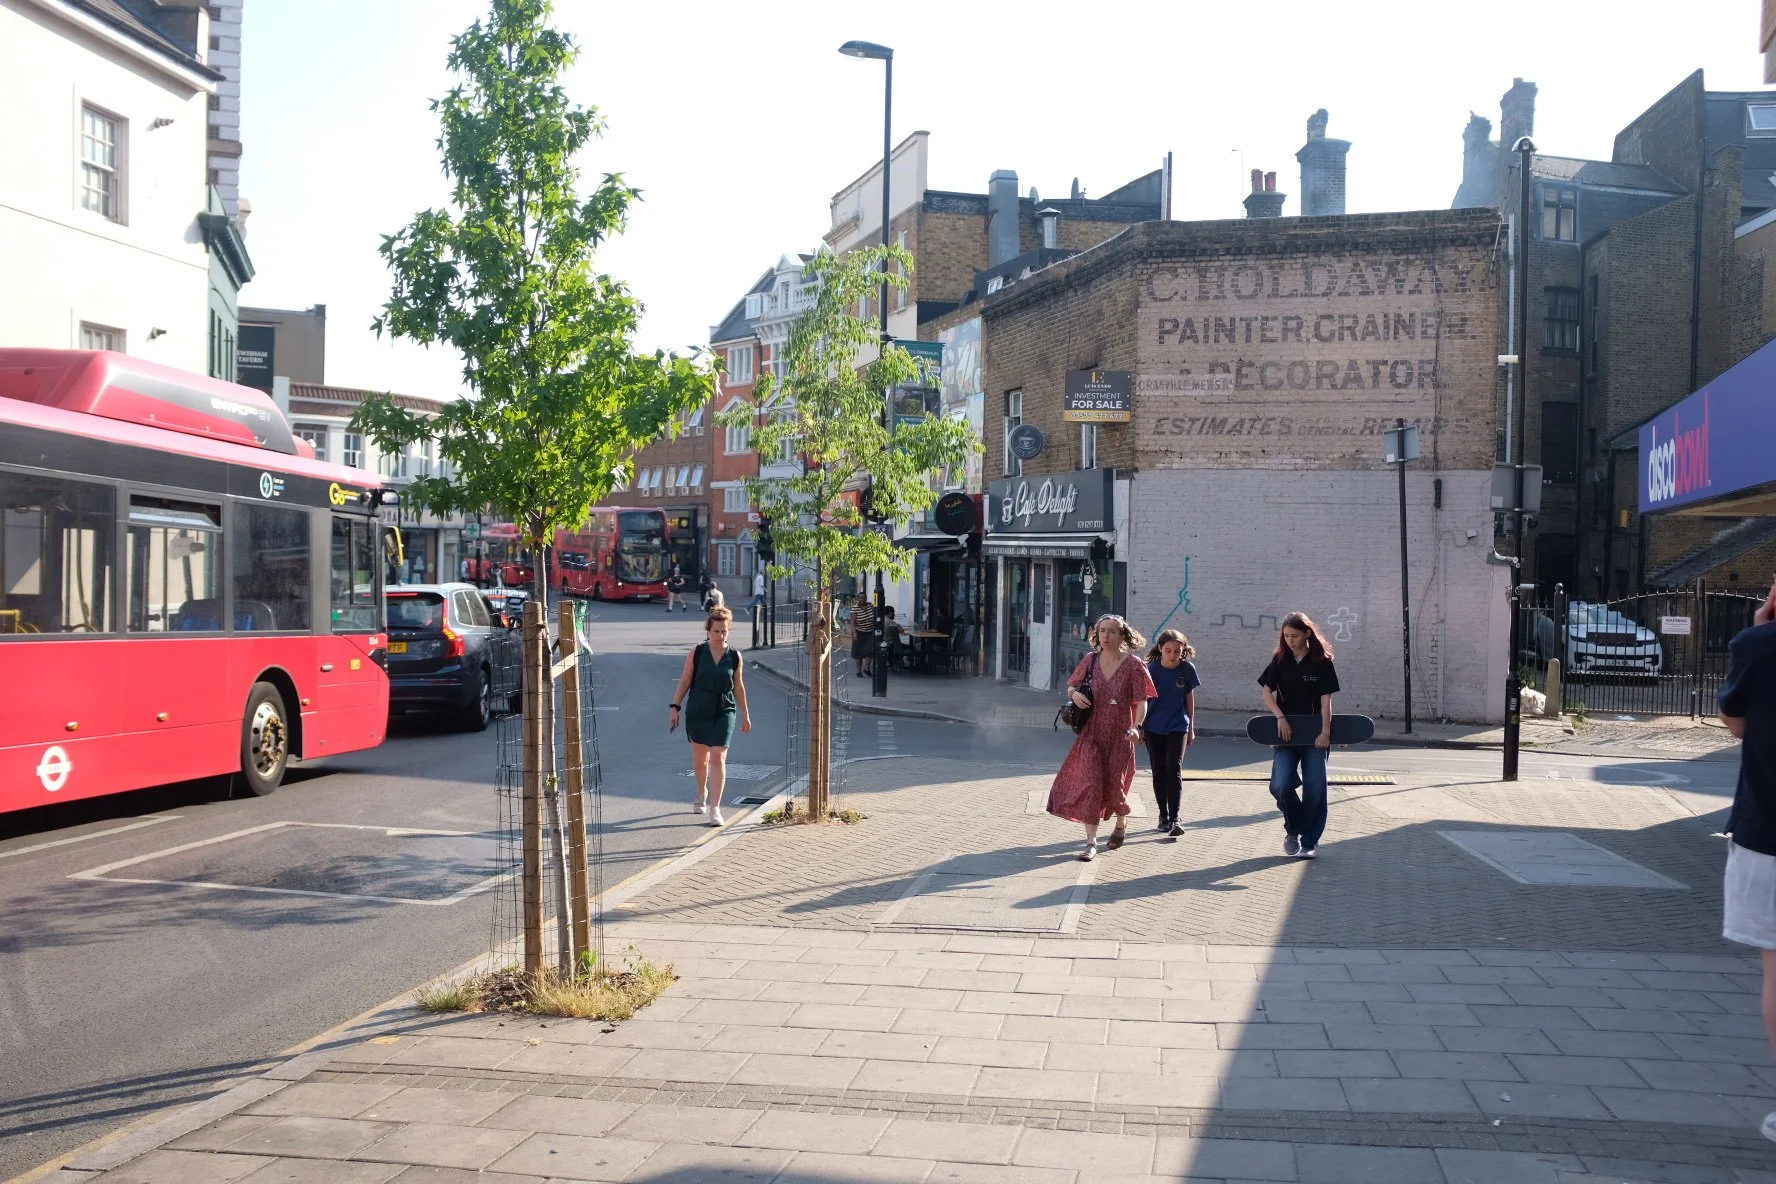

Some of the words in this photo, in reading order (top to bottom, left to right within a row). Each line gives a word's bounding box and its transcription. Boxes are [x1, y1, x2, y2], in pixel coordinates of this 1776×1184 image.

[1074, 392, 1121, 400] INVESTMENT
[1071, 400, 1094, 409] FOR
[1095, 400, 1123, 409] SALE
[1152, 416, 1294, 436] ESTIMATES
[1037, 477, 1079, 528] Delight
